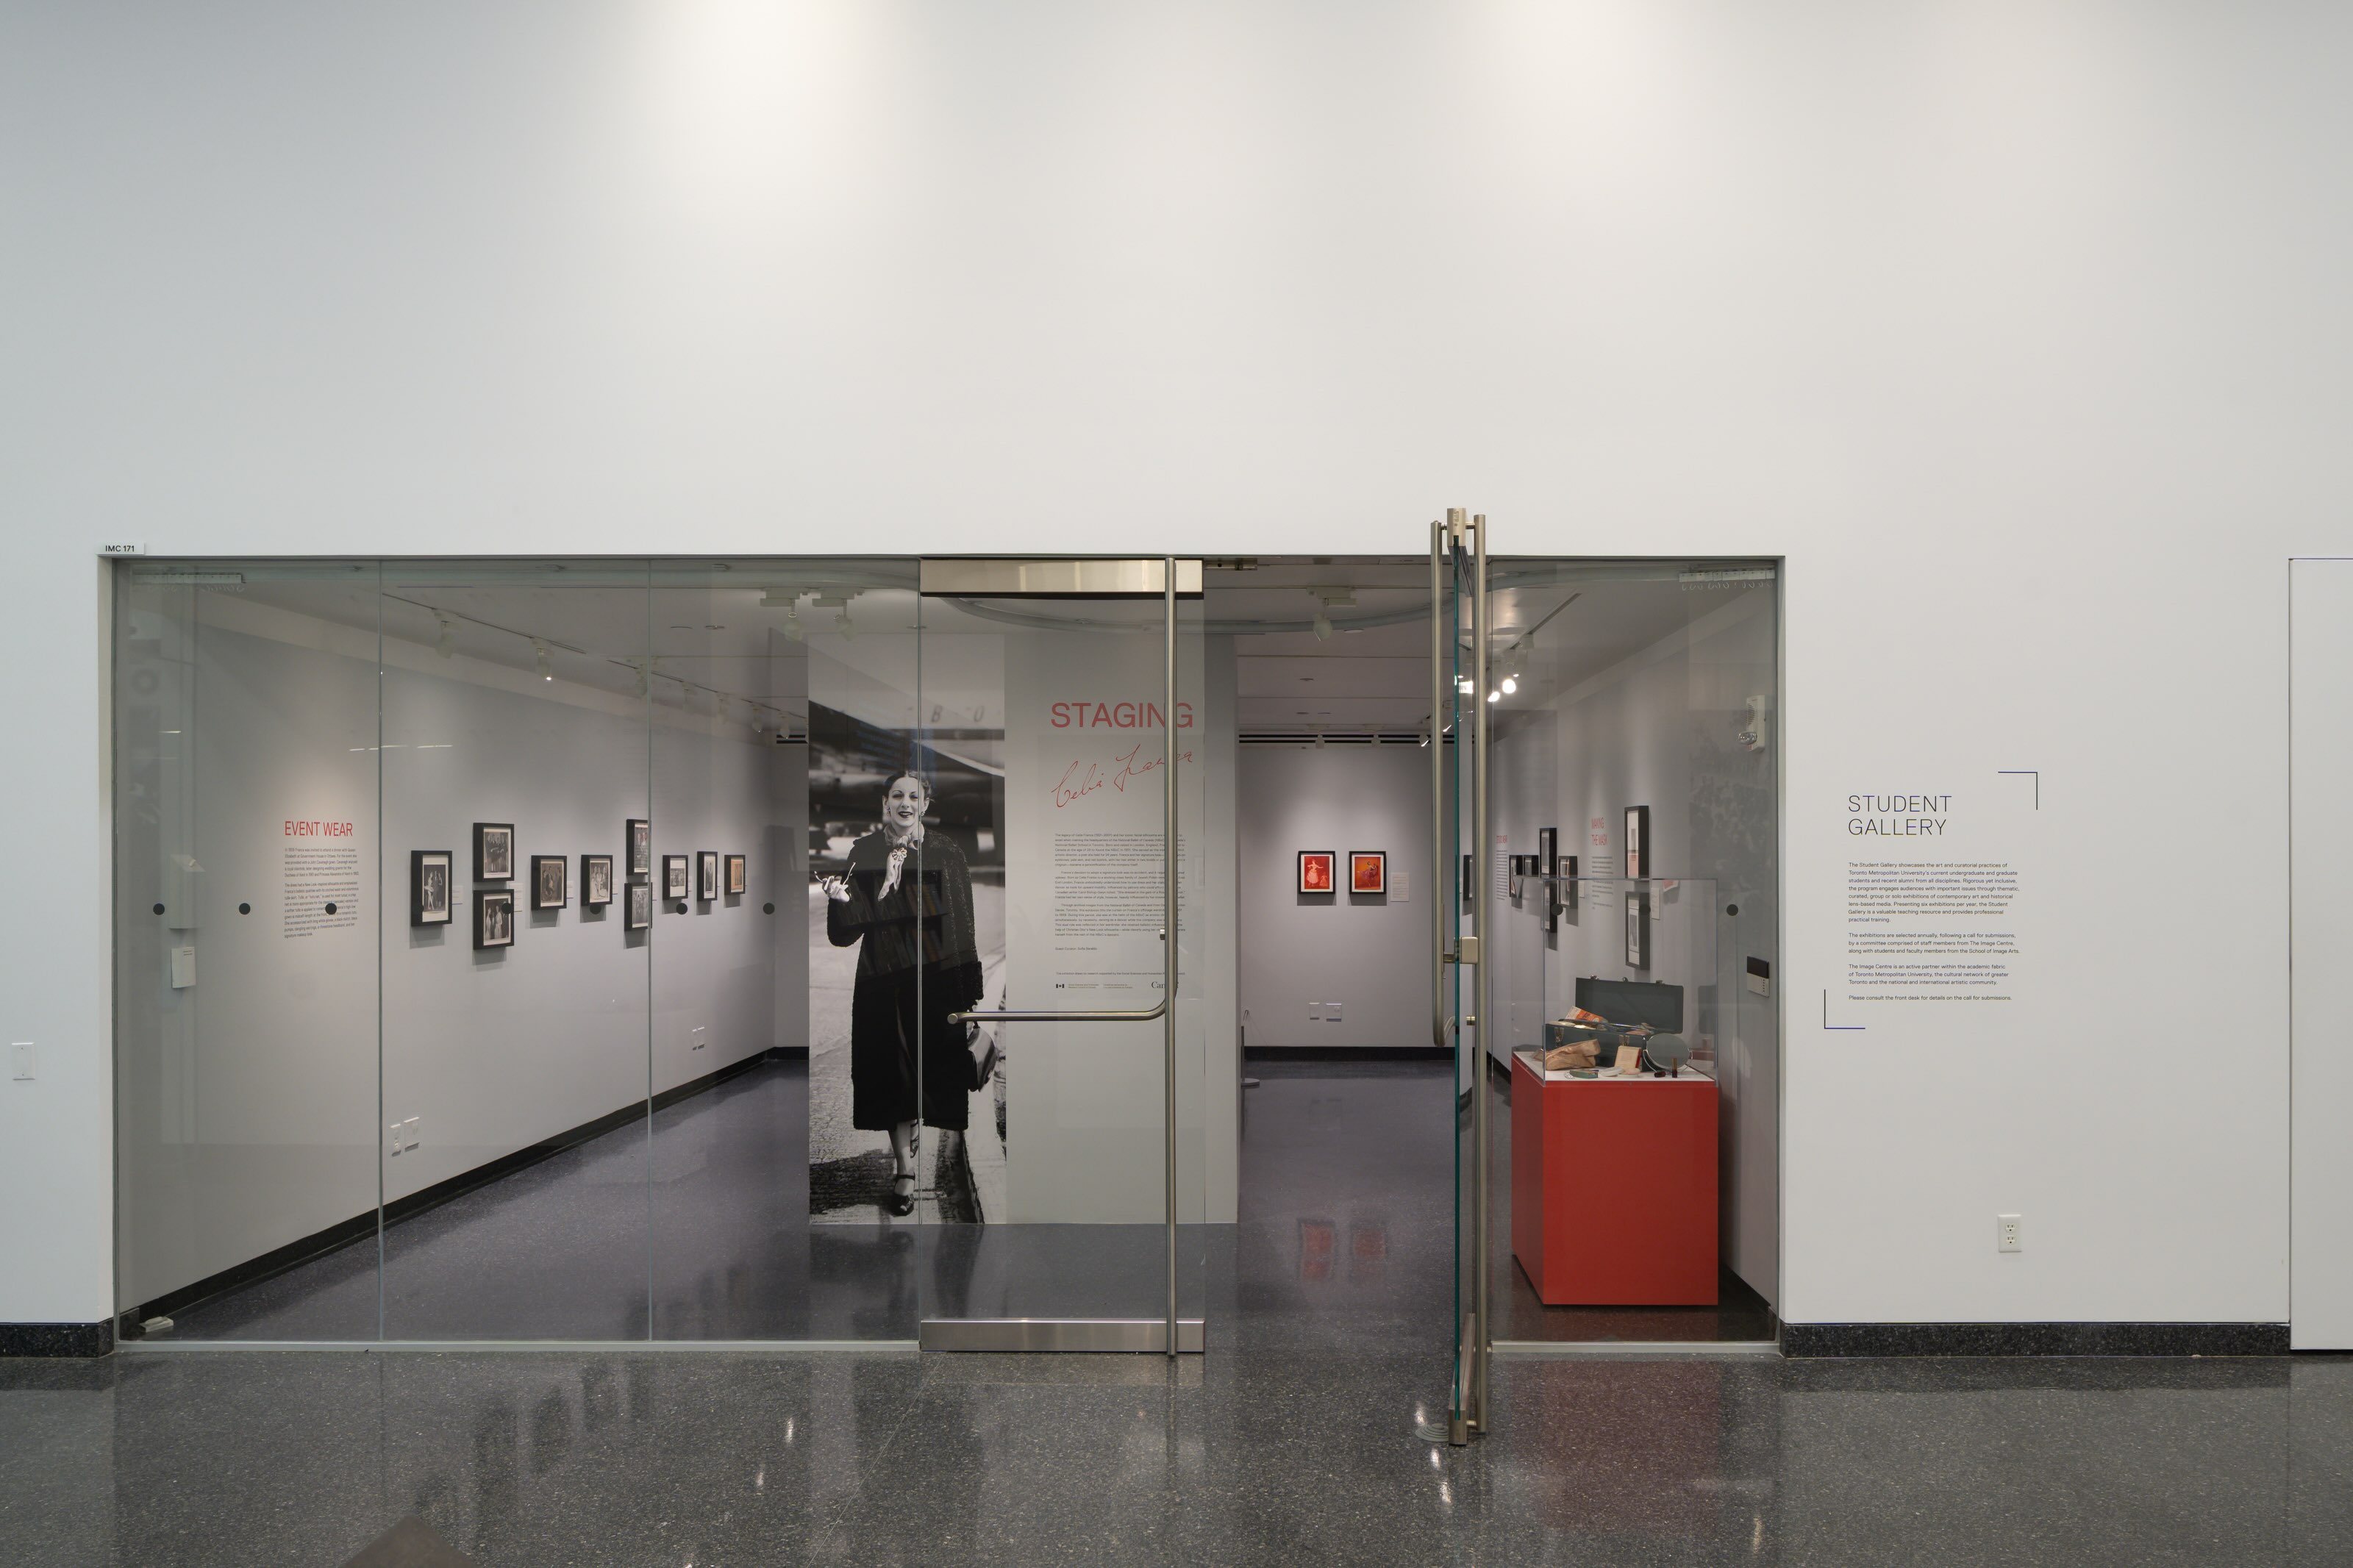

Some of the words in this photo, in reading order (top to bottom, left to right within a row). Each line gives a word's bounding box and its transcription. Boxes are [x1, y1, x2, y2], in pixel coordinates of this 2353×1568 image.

[1050, 702, 1193, 728] STAGING
[1848, 795, 1952, 812] STUDENT
[285, 821, 320, 836] EVENT
[323, 822, 353, 837] WEAR
[1848, 818, 1947, 835] GALLERY
